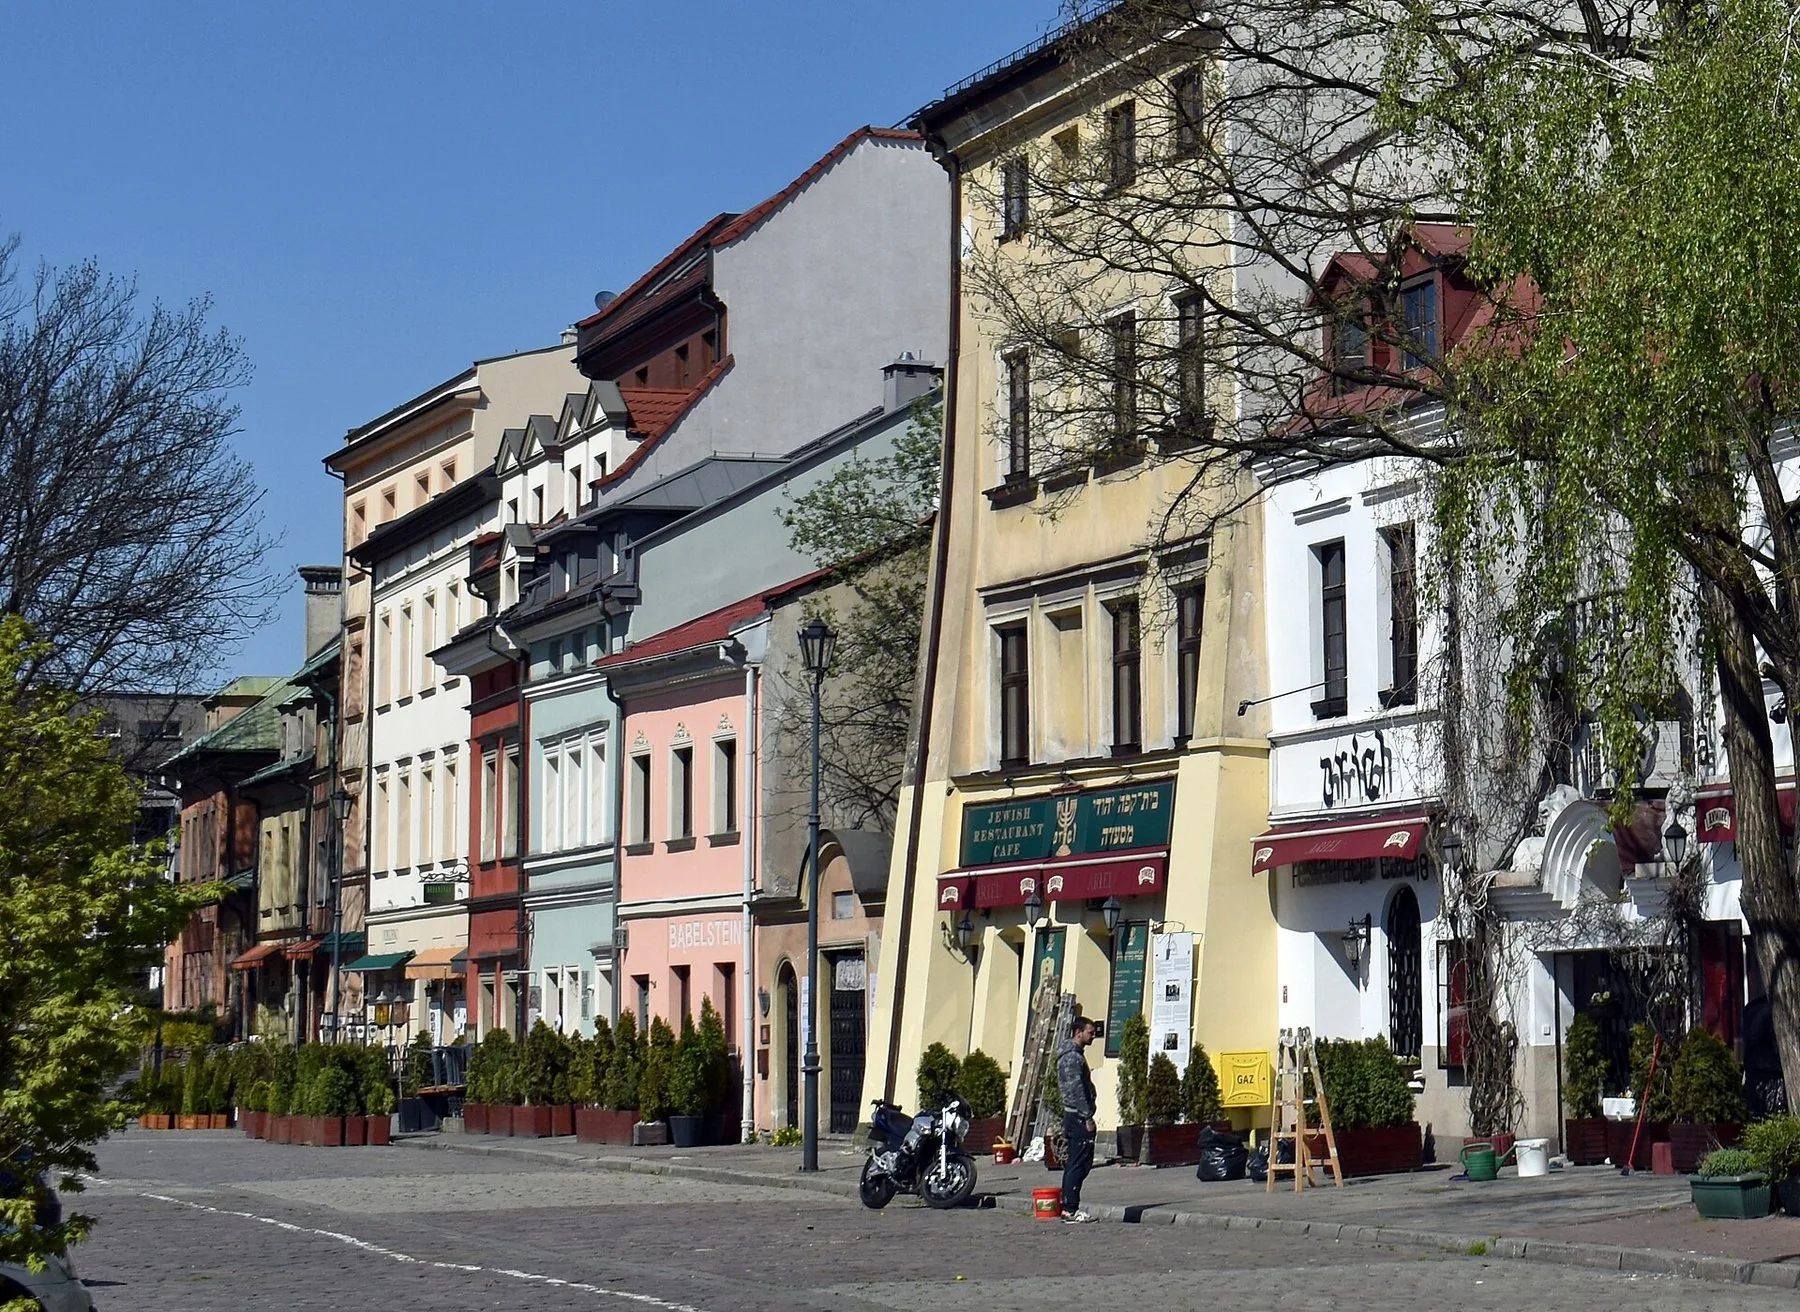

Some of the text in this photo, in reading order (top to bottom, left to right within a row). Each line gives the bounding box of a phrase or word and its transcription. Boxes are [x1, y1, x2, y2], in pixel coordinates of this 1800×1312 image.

[988, 807, 1031, 824] JEWISH
[973, 823, 1044, 843] RESTAURANT
[993, 843, 1021, 858] CAFE
[669, 920, 742, 953] BABELSTEIN
[1236, 1074, 1255, 1086] GAZ
